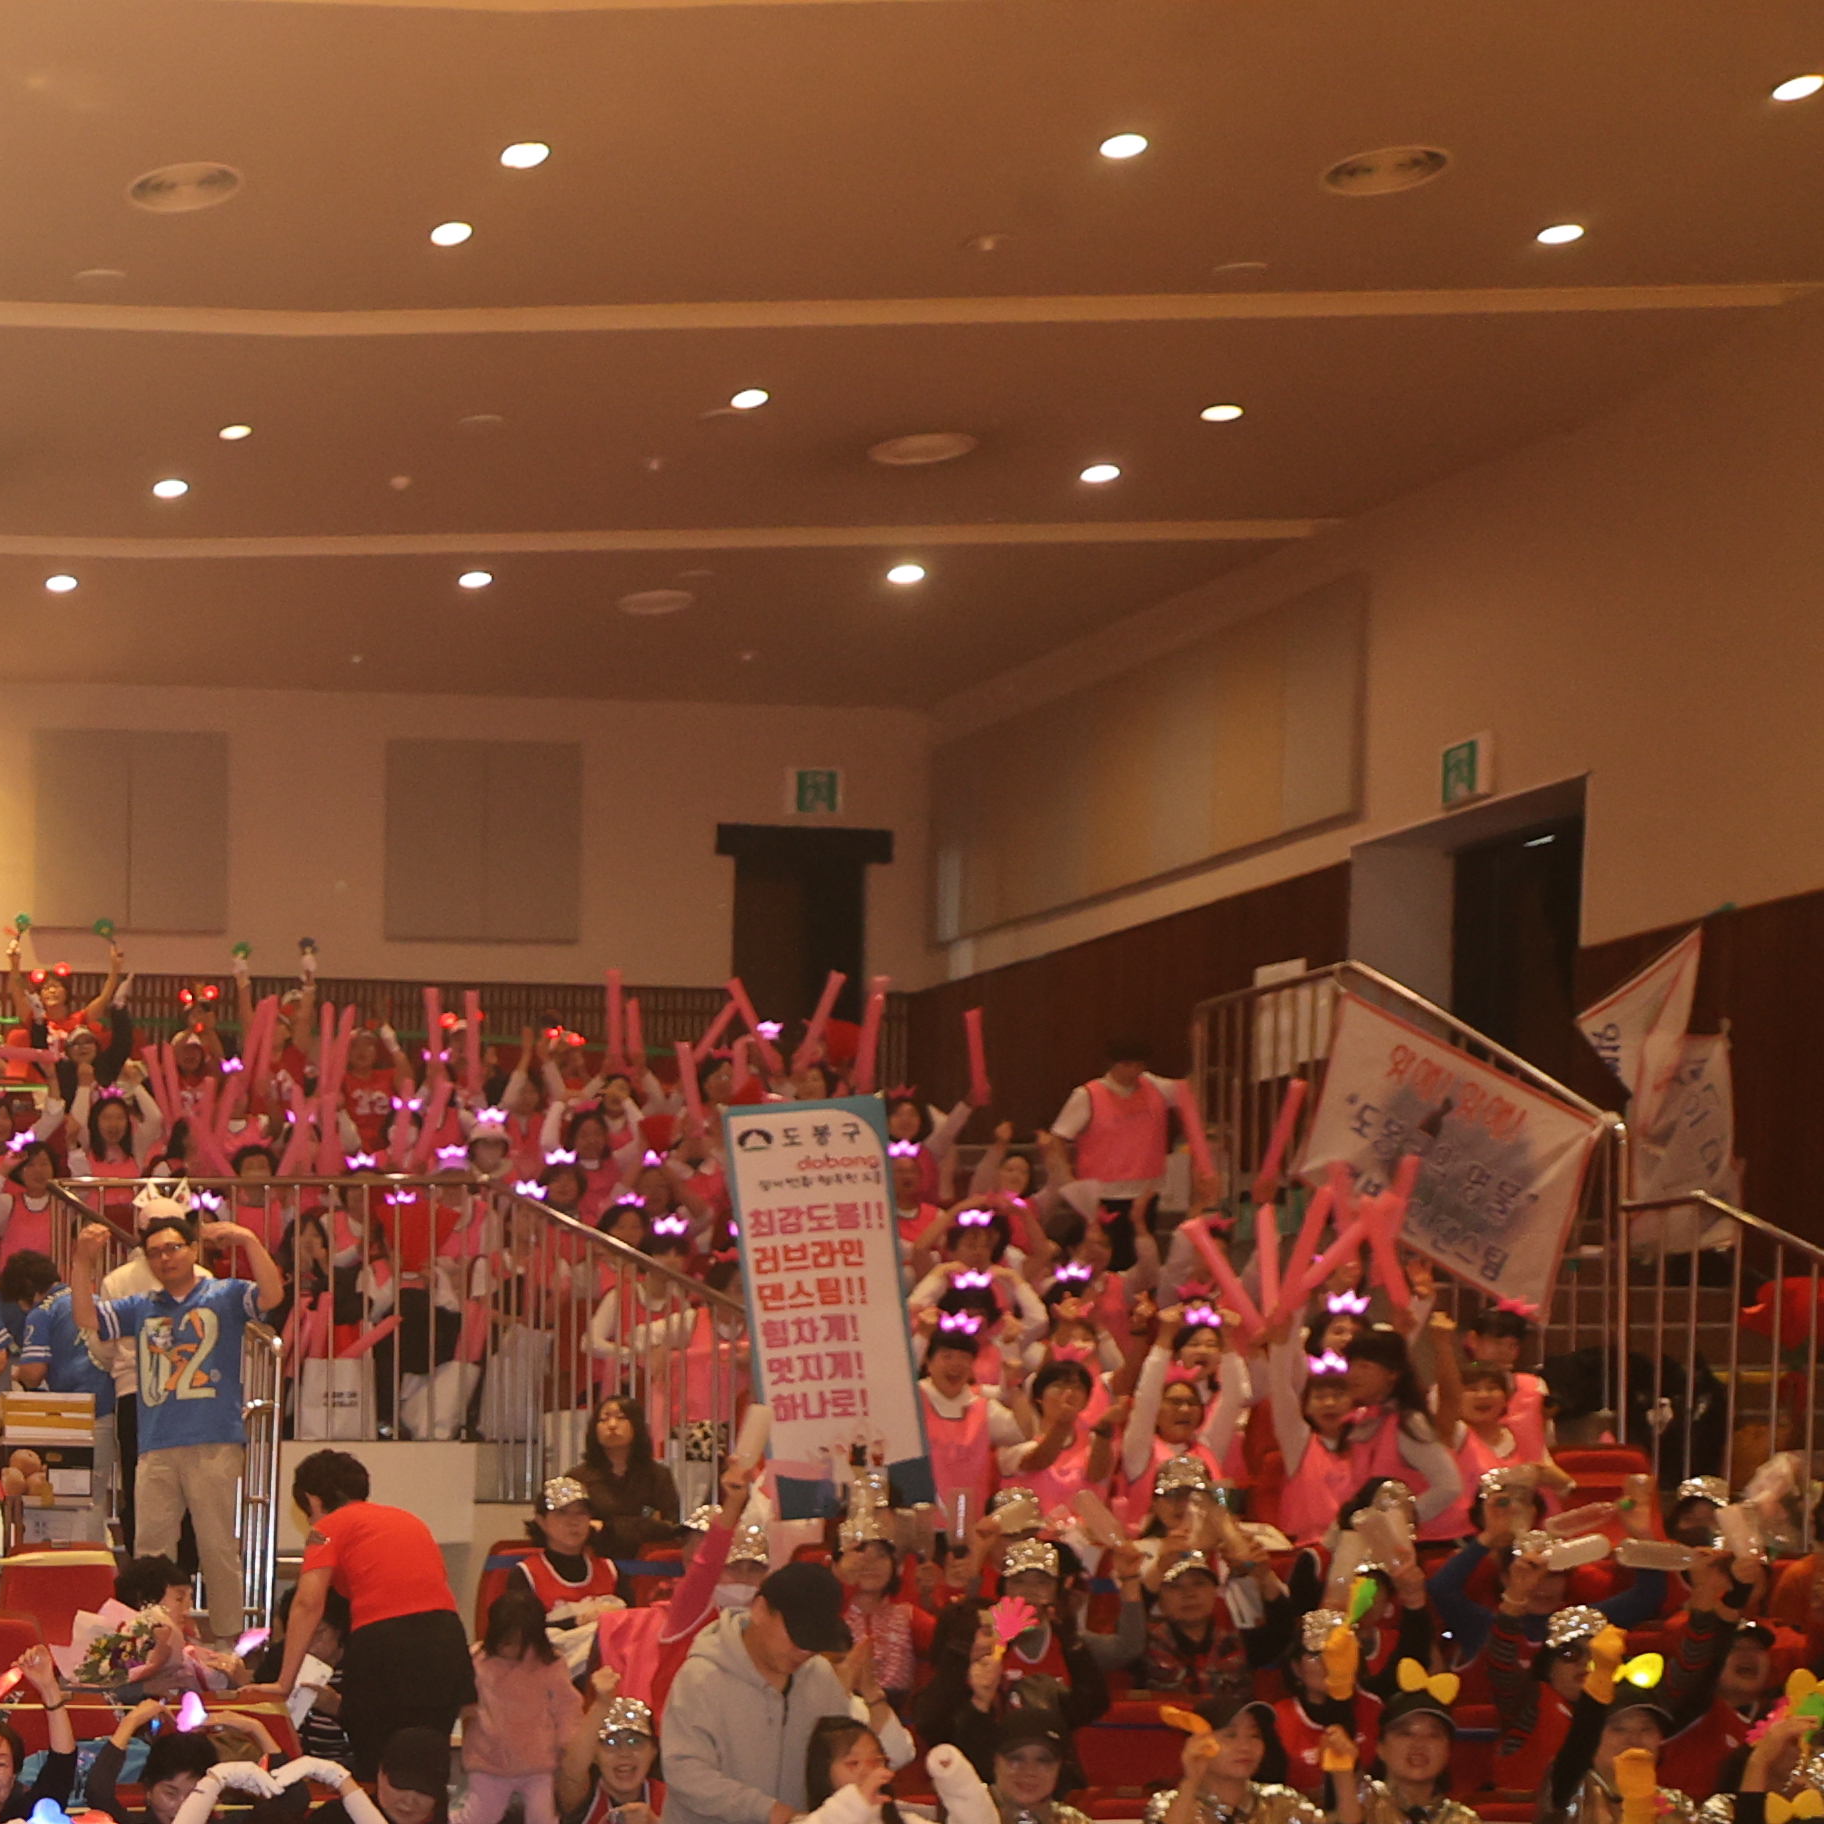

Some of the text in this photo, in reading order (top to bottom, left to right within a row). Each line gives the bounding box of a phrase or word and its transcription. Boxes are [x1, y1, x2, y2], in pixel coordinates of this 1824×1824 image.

[782, 1122, 862, 1147] 도봉구
[760, 1313, 860, 1349] 힘차게!
[766, 1350, 865, 1386] 멋지게!
[770, 1388, 871, 1422] 하나로!
